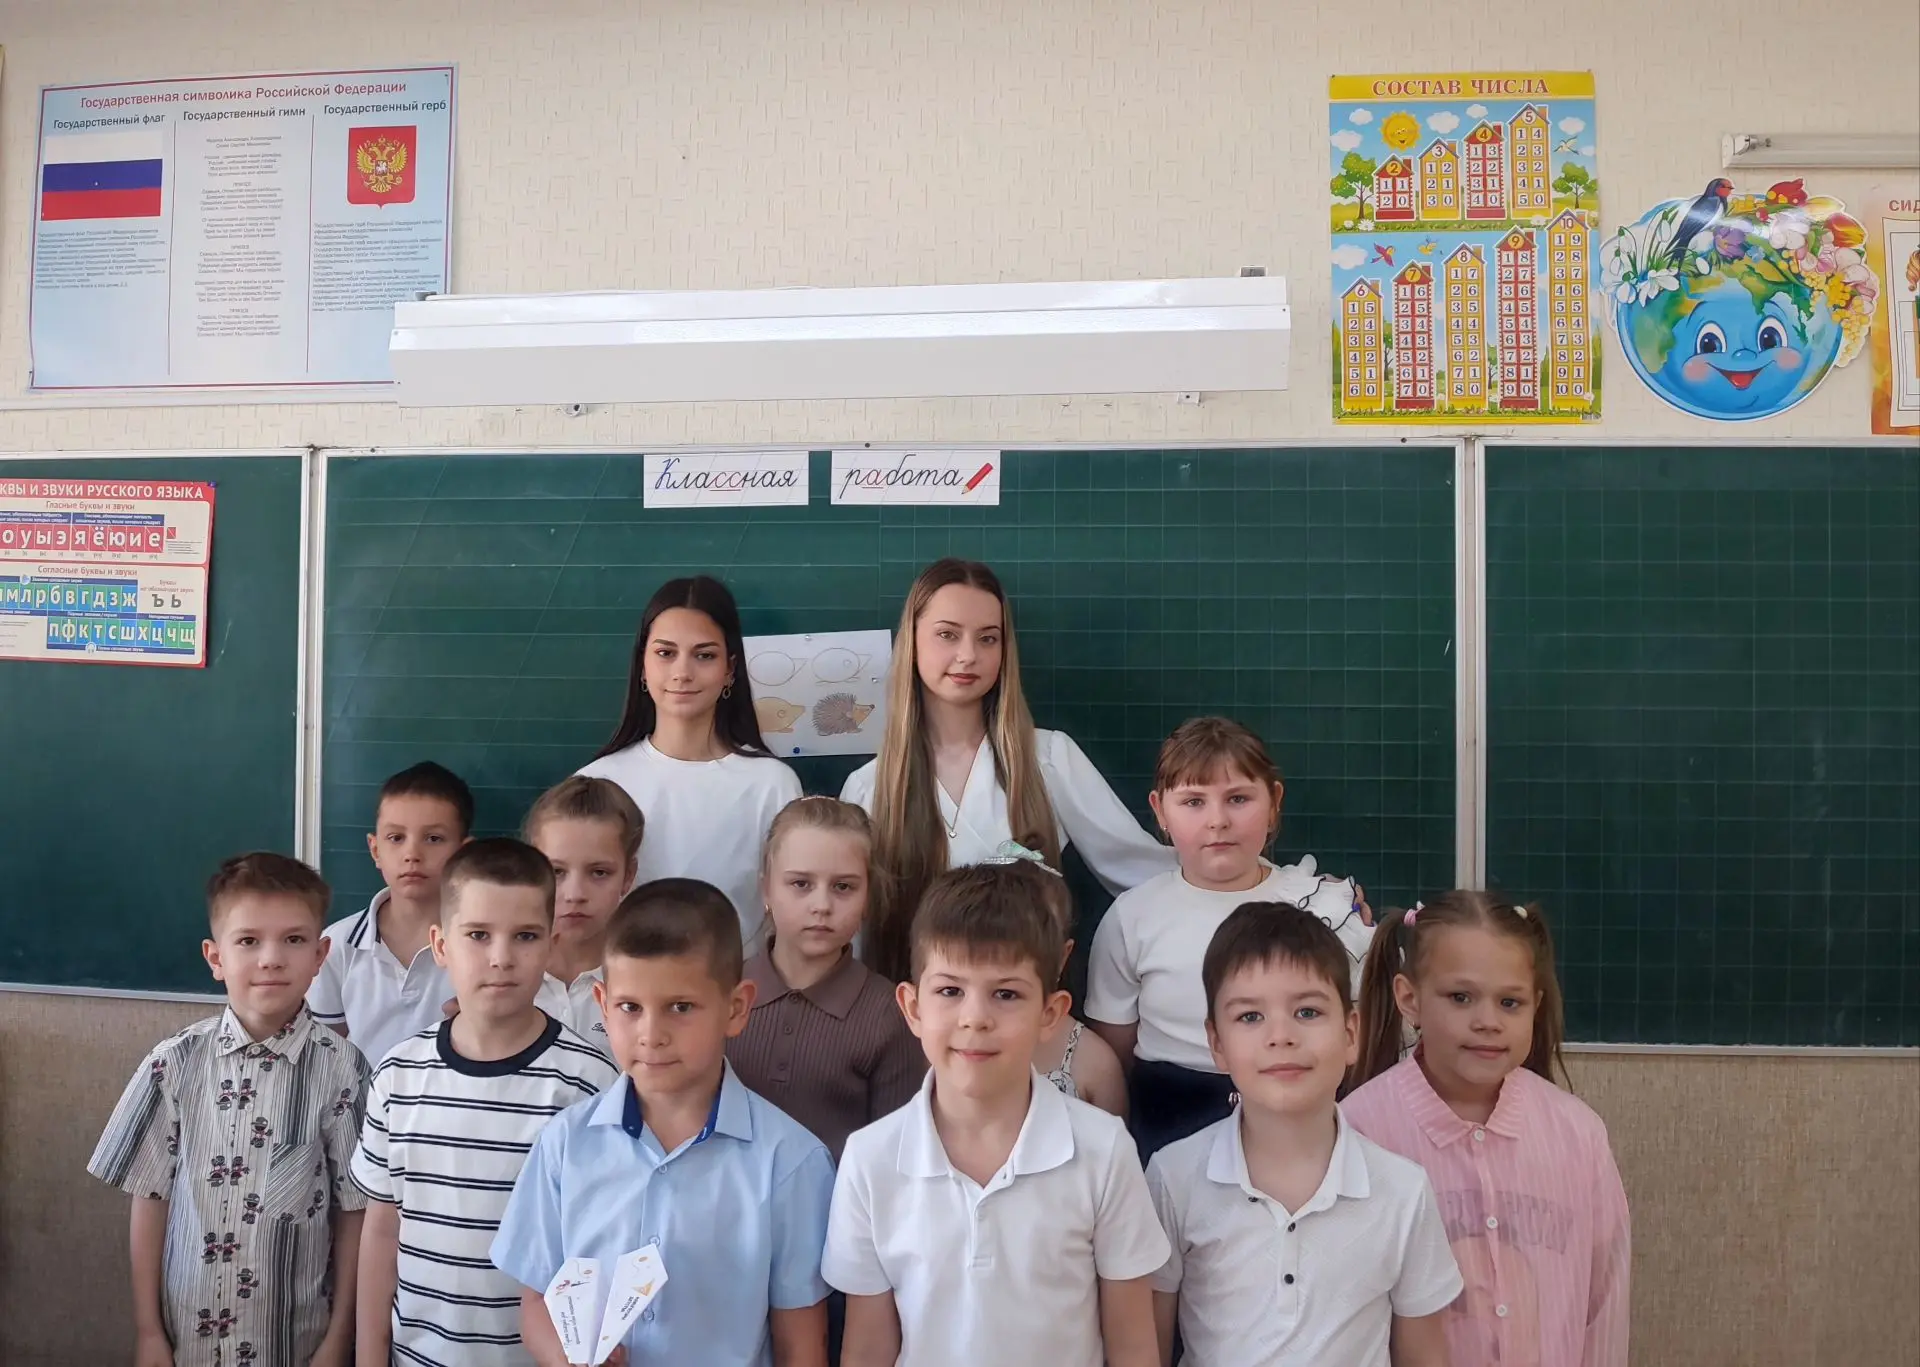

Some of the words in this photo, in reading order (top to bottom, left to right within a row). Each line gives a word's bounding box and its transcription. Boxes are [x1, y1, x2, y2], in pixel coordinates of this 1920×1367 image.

[1373, 80, 1461, 96] СОСТАВ
[1471, 79, 1548, 94] ЧИСЛА
[80, 92, 178, 109] Государственная
[183, 89, 251, 102] символика
[256, 84, 330, 98] Российской
[334, 82, 406, 96] Федерации
[324, 101, 418, 116] Государственный
[422, 100, 446, 112] герб
[184, 107, 276, 122] Государственный
[278, 107, 306, 117] гимн
[1525, 111, 1533, 123] 5
[54, 114, 140, 130] Государственный
[142, 114, 166, 126] флаг
[1480, 129, 1488, 139] 4
[1518, 129, 1524, 138] 1
[1533, 129, 1540, 138] 4
[1435, 146, 1443, 157] 3
[1473, 147, 1479, 155] 1
[1489, 146, 1496, 155] 3
[1518, 146, 1525, 155] 2
[1534, 146, 1541, 155] 3
[1390, 163, 1398, 173] 2
[1428, 164, 1434, 173] 1
[1444, 163, 1451, 172] 2
[1473, 163, 1480, 172] 2
[1489, 161, 1497, 171] 2
[1518, 162, 1526, 171] 3
[1534, 162, 1542, 171] 2
[1383, 180, 1389, 189] 1
[1399, 180, 1405, 189] 1
[1428, 180, 1435, 188] 2
[1445, 180, 1451, 188] 1
[1473, 179, 1480, 188] 3
[1490, 179, 1496, 187] 1
[1518, 179, 1526, 187] 4
[1535, 179, 1541, 187] 1
[1383, 196, 1391, 206] 2
[1399, 196, 1406, 205] 0
[1428, 196, 1436, 206] 3
[1444, 196, 1452, 204] 0
[1472, 195, 1480, 204] 4
[1490, 195, 1498, 204] 0
[1520, 195, 1527, 204] 5
[1535, 195, 1543, 203] 0
[1561, 218, 1574, 229] 10
[1512, 235, 1520, 247] 9
[1557, 235, 1563, 244] 1
[1572, 235, 1580, 244] 9
[1460, 251, 1468, 262] 8
[1505, 253, 1511, 263] 1
[1521, 253, 1529, 262] 8
[1409, 269, 1417, 280] 7
[1454, 269, 1460, 278] 1
[1469, 269, 1477, 278] 7
[1504, 270, 1512, 279] 2
[1521, 270, 1528, 279] 7
[1357, 285, 1365, 296] 6
[1402, 287, 1408, 296] 1
[1417, 287, 1426, 296] 6
[1453, 286, 1460, 295] 2
[1469, 286, 1476, 295] 6
[1350, 303, 1356, 312] 1
[1366, 303, 1374, 312] 5
[1401, 304, 1409, 313] 2
[1417, 303, 1425, 313] 5
[1453, 302, 1460, 311] 3
[1469, 302, 1477, 311] 5
[1350, 319, 1358, 329] 2
[1365, 320, 1373, 329] 4
[1401, 320, 1409, 329] 3
[1417, 320, 1425, 329] 4
[1452, 319, 1460, 328] 4
[1470, 318, 1478, 328] 4
[1350, 336, 1358, 345] 3
[1366, 336, 1374, 345] 3
[1400, 336, 1408, 345] 4
[1418, 336, 1426, 345] 3
[1454, 335, 1461, 344] 5
[1470, 335, 1477, 344] 3
[1349, 353, 1357, 362] 4
[1367, 353, 1374, 362] 2
[1402, 352, 1410, 361] 5
[1418, 352, 1426, 362] 2
[1454, 351, 1462, 360] 6
[1471, 351, 1478, 360] 2
[1351, 369, 1359, 378] 5
[1368, 369, 1374, 378] 1
[1402, 368, 1410, 377] 6
[1420, 369, 1426, 377] 1
[1455, 368, 1462, 377] 7
[1472, 368, 1478, 377] 1
[1350, 385, 1358, 394] 6
[1367, 385, 1375, 394] 0
[1403, 385, 1411, 394] 7
[1419, 385, 1427, 394] 0
[1455, 385, 1463, 394] 8
[1471, 385, 1479, 394] 0
[1556, 385, 1568, 395] 10
[1574, 385, 1582, 394] 0
[654, 456, 797, 489] Классная
[840, 454, 964, 499] работа
[0, 484, 26, 495] КВЫ
[30, 484, 38, 495] И
[42, 484, 83, 496] ЗВУКИ
[88, 485, 152, 497] РУССКОГО
[156, 486, 204, 498] ЯЗЫКА
[46, 501, 78, 509] Гласные
[80, 501, 103, 510] буквы
[113, 504, 135, 512] звуки
[38, 566, 78, 574] Согласные
[81, 566, 105, 576] буквы
[115, 569, 138, 577] звуки
